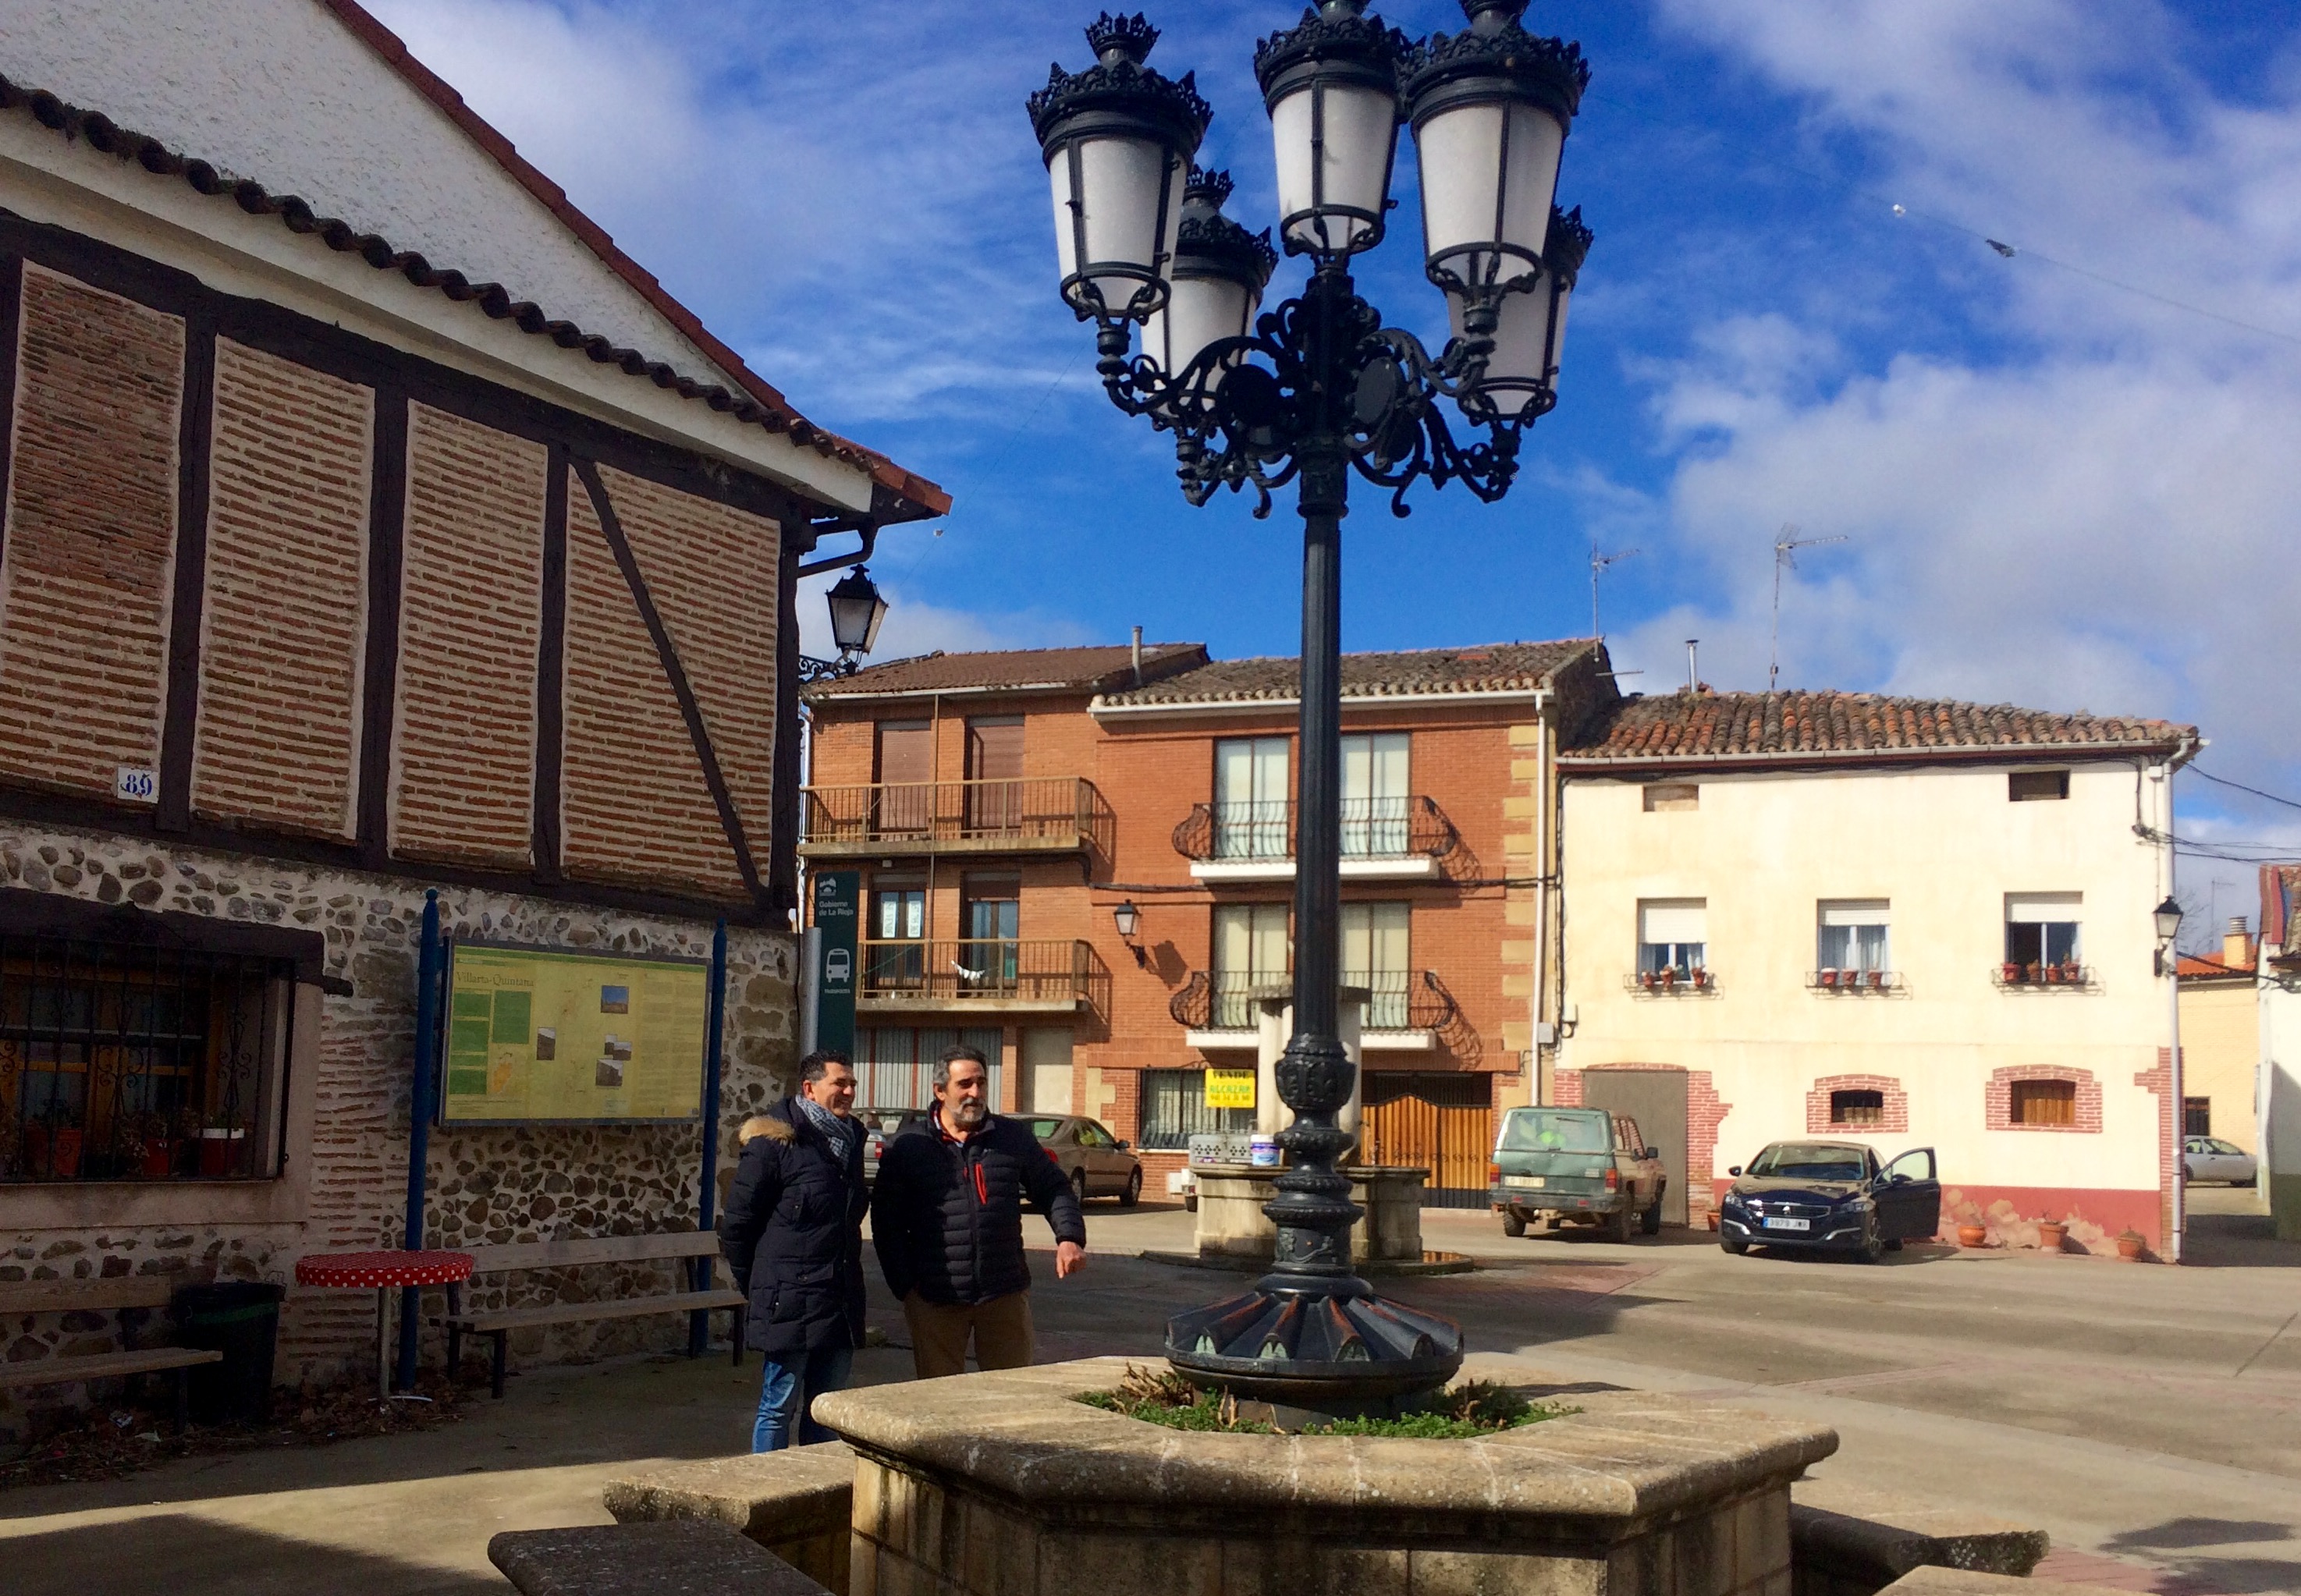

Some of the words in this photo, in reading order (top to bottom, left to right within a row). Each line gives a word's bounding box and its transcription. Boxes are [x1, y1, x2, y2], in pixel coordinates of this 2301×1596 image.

[126, 772, 153, 796] 89
[837, 908, 854, 917] Rioja
[456, 971, 534, 987] Villarta-Quintana
